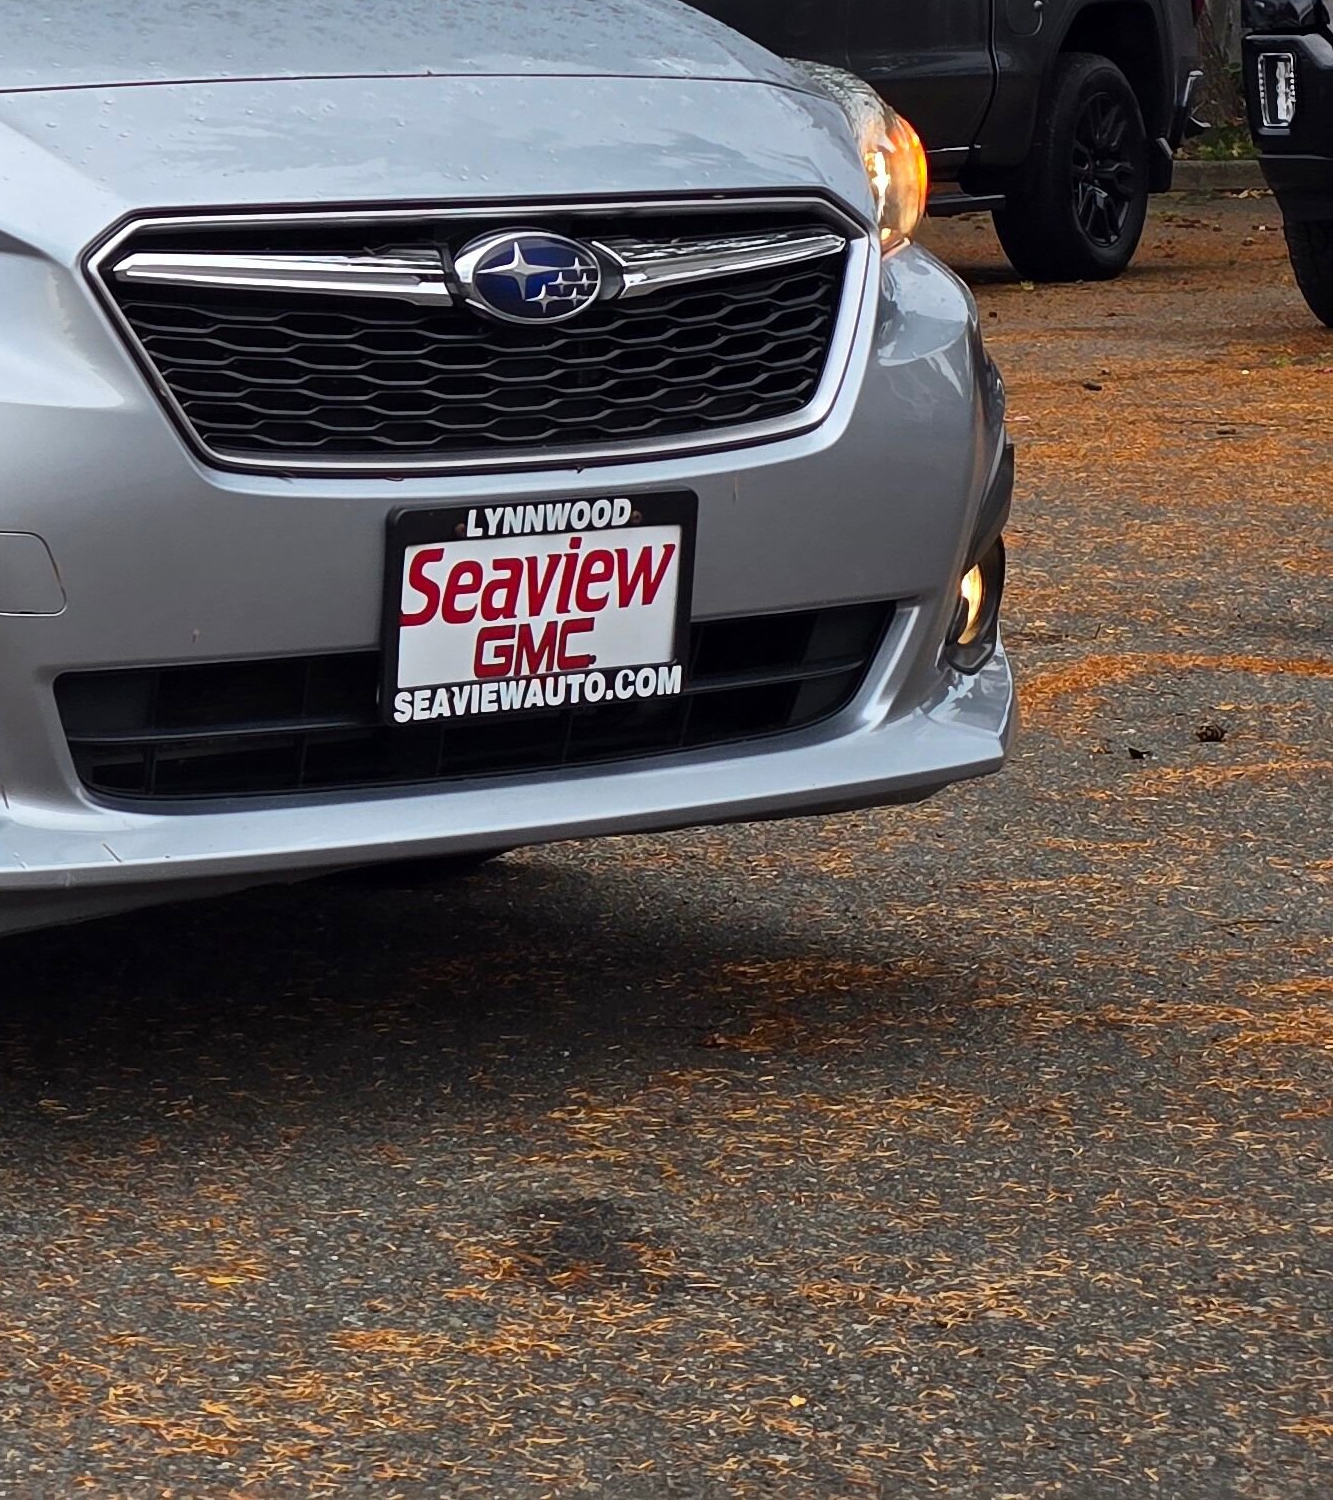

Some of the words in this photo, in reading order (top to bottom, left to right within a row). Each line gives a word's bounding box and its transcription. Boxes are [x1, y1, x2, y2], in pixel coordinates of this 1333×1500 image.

[465, 498, 633, 538] LYNNWOOD
[399, 536, 676, 627] Seaview
[473, 616, 597, 679] GMC
[393, 664, 682, 724] SEAVIEWAUTO.COM
